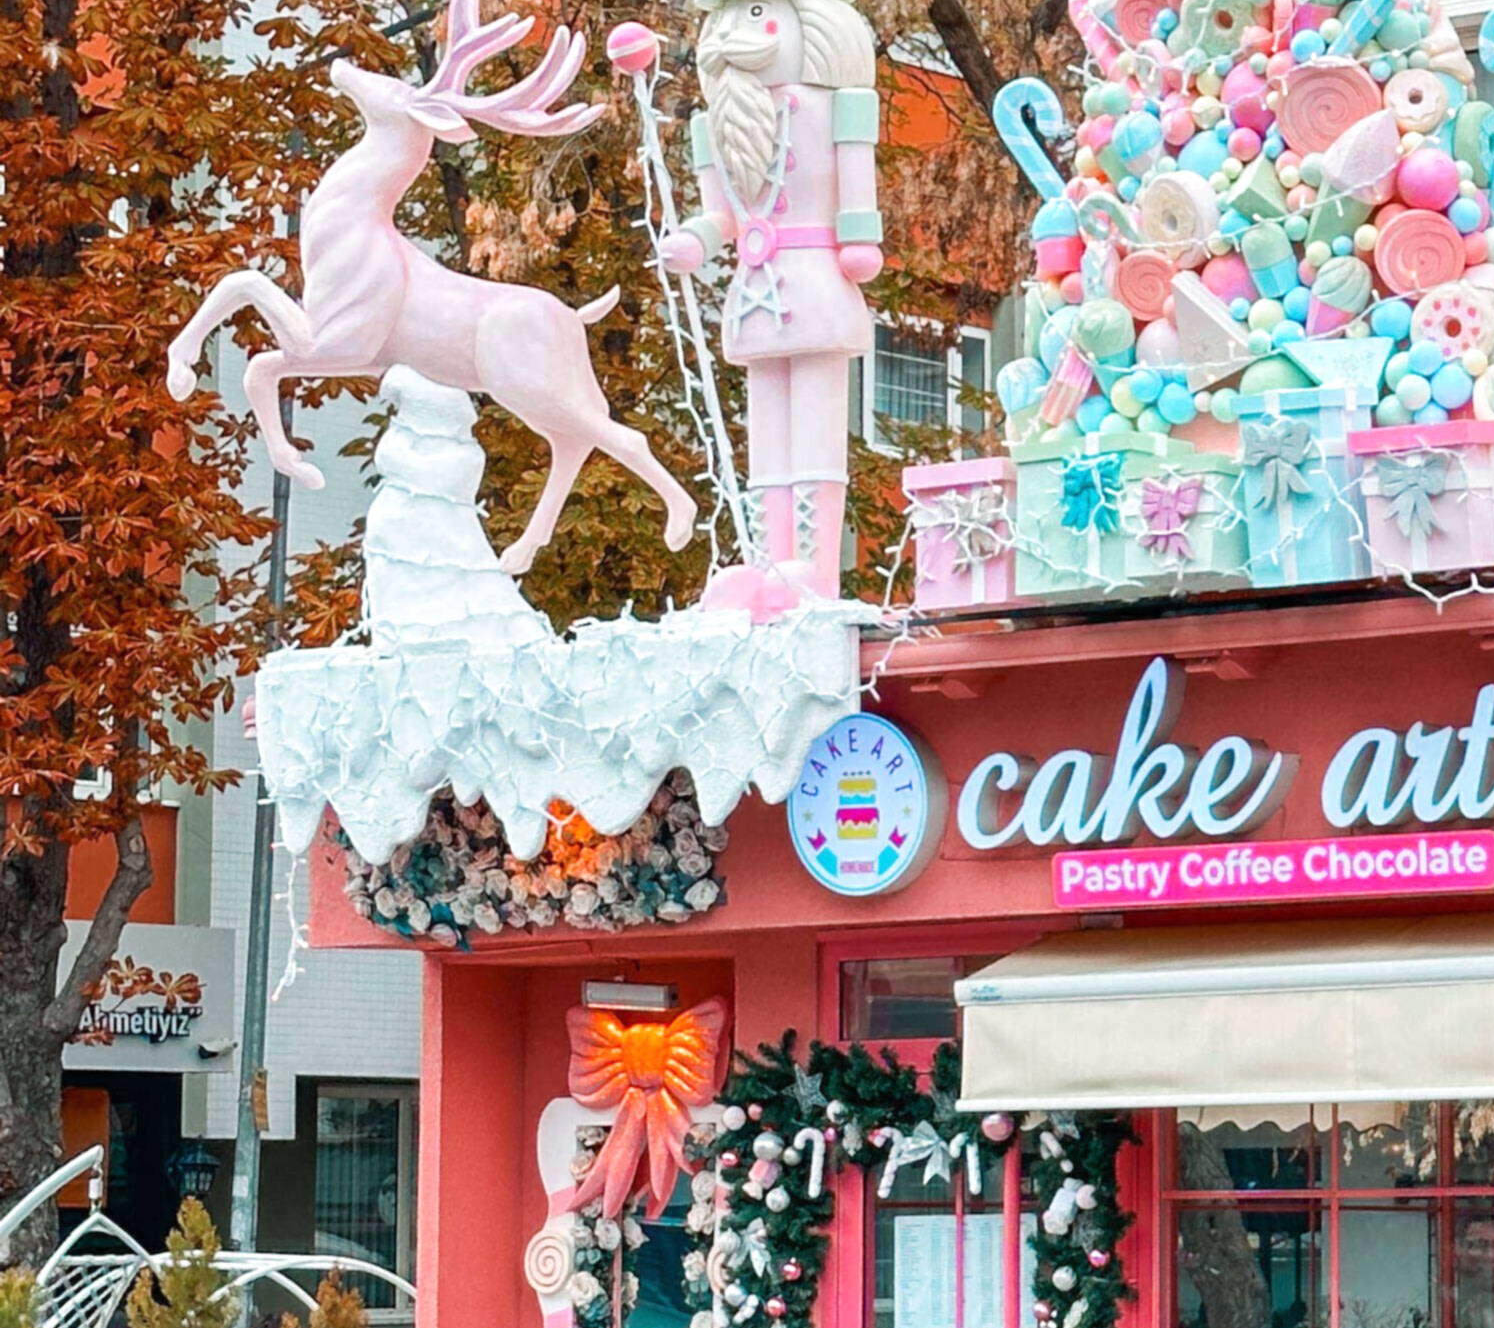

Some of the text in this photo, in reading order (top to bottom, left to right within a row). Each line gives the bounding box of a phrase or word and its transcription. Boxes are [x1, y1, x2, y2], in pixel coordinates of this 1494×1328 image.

[800, 728, 914, 798] CAKE ART
[957, 656, 1283, 850] cake
[1061, 838, 1489, 898] Pastry Coffee Chocolate
